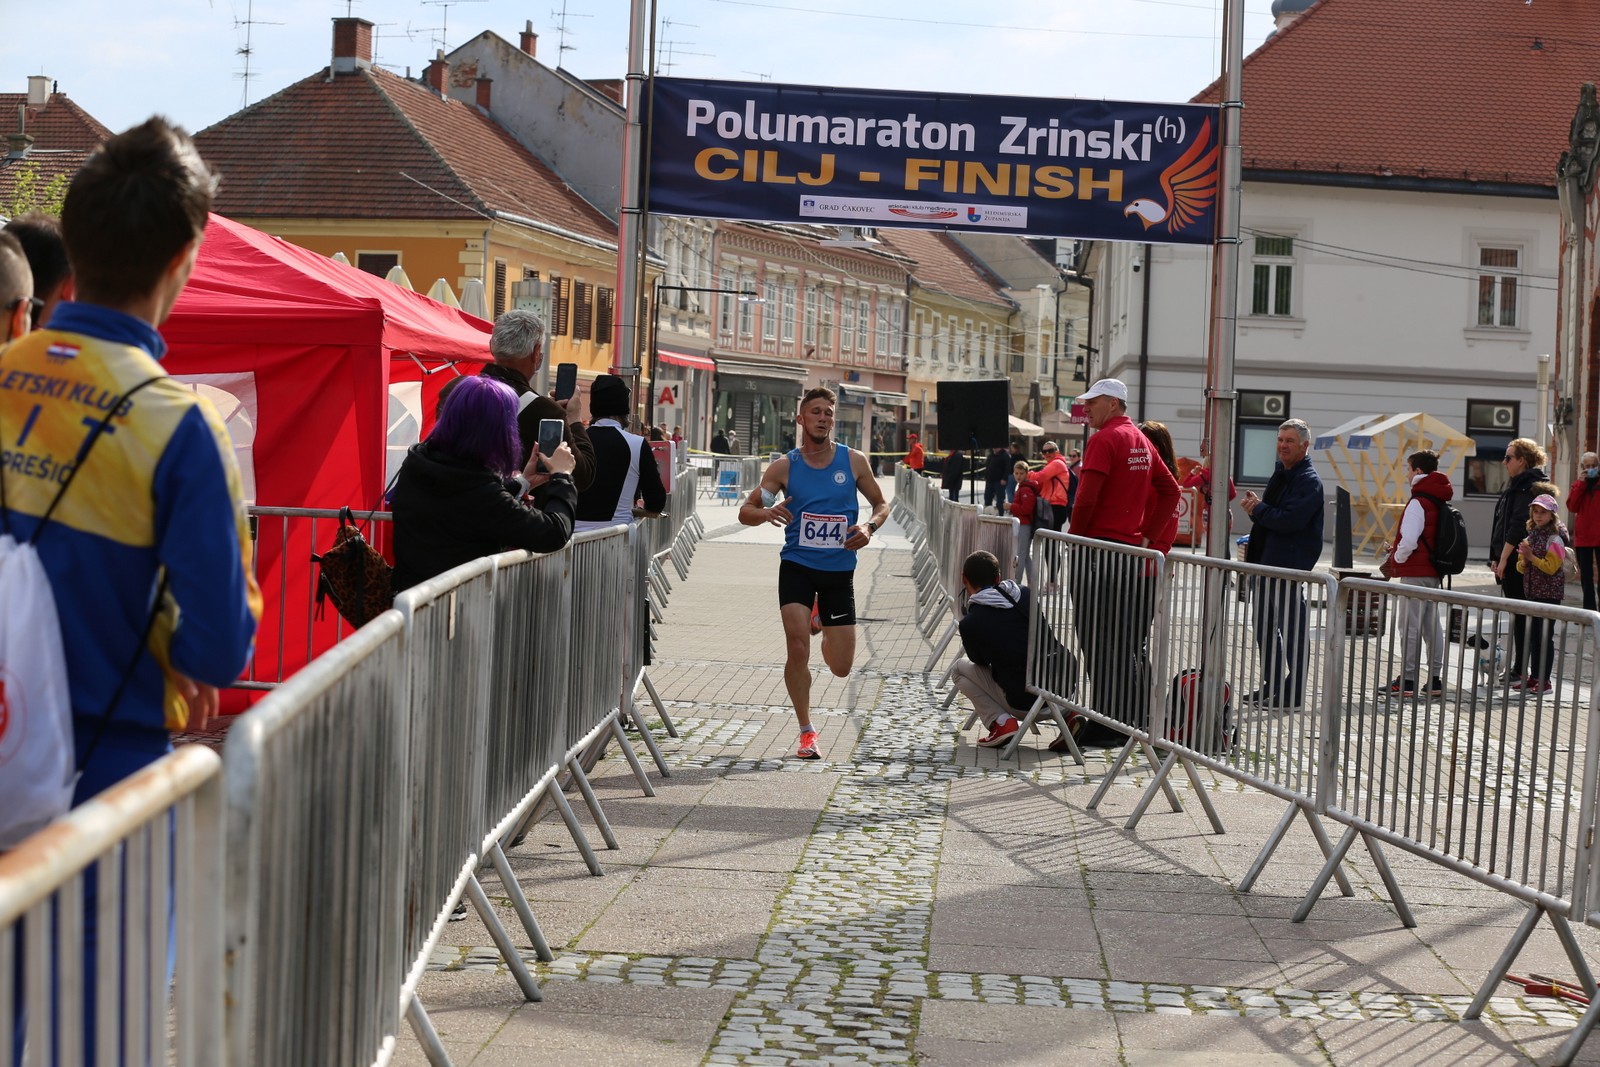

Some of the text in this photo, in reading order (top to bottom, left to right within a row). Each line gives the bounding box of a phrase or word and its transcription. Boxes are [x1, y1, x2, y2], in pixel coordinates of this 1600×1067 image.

[686, 99, 976, 152] Polumaraton
[694, 147, 836, 187] CILJ
[904, 158, 1124, 203] FINISH
[819, 203, 875, 213] GRAD ČAKOVEC
[69, 382, 134, 417] KLUB
[658, 385, 678, 405] A1
[1071, 416, 1089, 424] BIPA
[805, 521, 841, 541] 644
